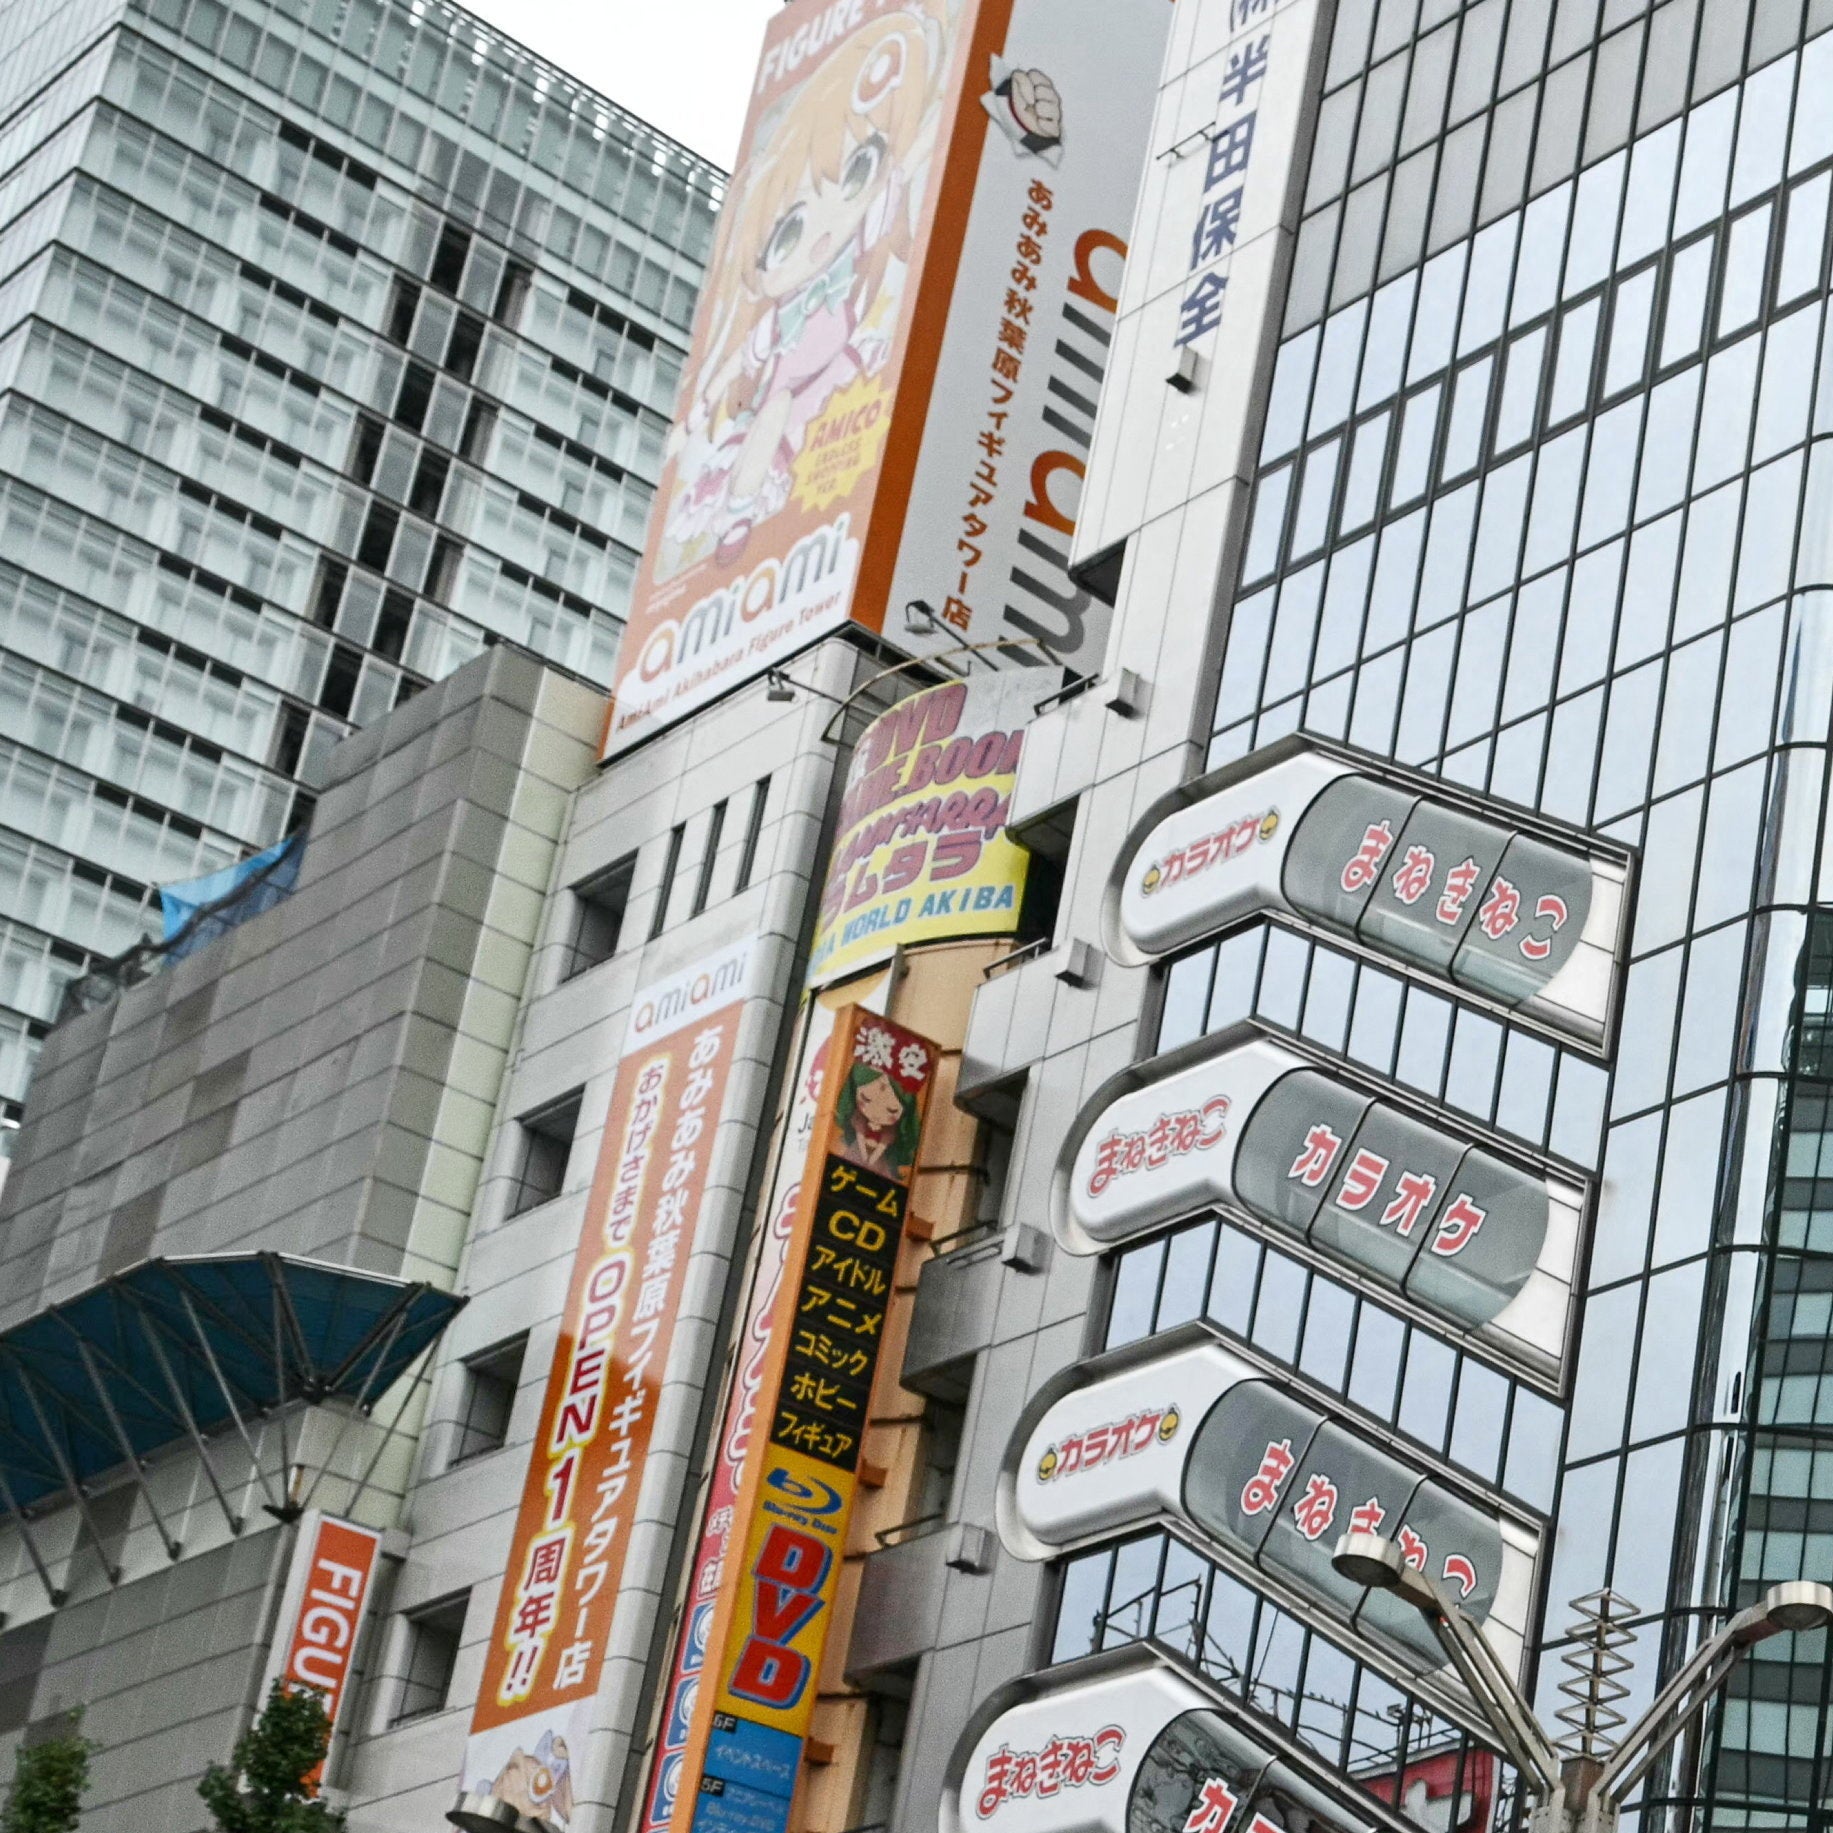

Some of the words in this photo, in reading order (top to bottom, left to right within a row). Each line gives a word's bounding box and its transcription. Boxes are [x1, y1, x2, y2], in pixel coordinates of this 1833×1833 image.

[756, 1, 863, 96] FIGURE
[812, 398, 882, 450] AMICO
[941, 178, 1054, 632] あみあみ秋葉原フィギュアタワー店
[638, 519, 845, 683] amiami
[673, 649, 744, 699] Akihabara
[748, 619, 795, 656] Figure
[799, 590, 842, 631] Tower
[1159, 811, 1261, 885] カラオケ
[918, 884, 1015, 918] AKIBA
[1339, 819, 1570, 960] まねきねこ
[634, 950, 746, 1036] amiami
[854, 1026, 930, 1084] 激安
[1085, 1094, 1233, 1199] まねきねこ
[830, 1163, 898, 1217] ゲーム
[1288, 1120, 1487, 1258] カラオケ
[828, 1209, 887, 1252] CD
[809, 1243, 887, 1297] アイドル
[801, 1284, 882, 1336] アニメ
[552, 1024, 724, 1690] あみあみ秋葉原フィギュアタワー店
[795, 1330, 868, 1377] コミック
[790, 1371, 857, 1411] ホビー
[778, 1411, 852, 1460] フィギュア
[1055, 1412, 1163, 1479] カラオケ
[729, 1521, 834, 1711] DVD
[701, 1777, 725, 1795] 5F
[976, 1723, 1128, 1820] まねきねこ
